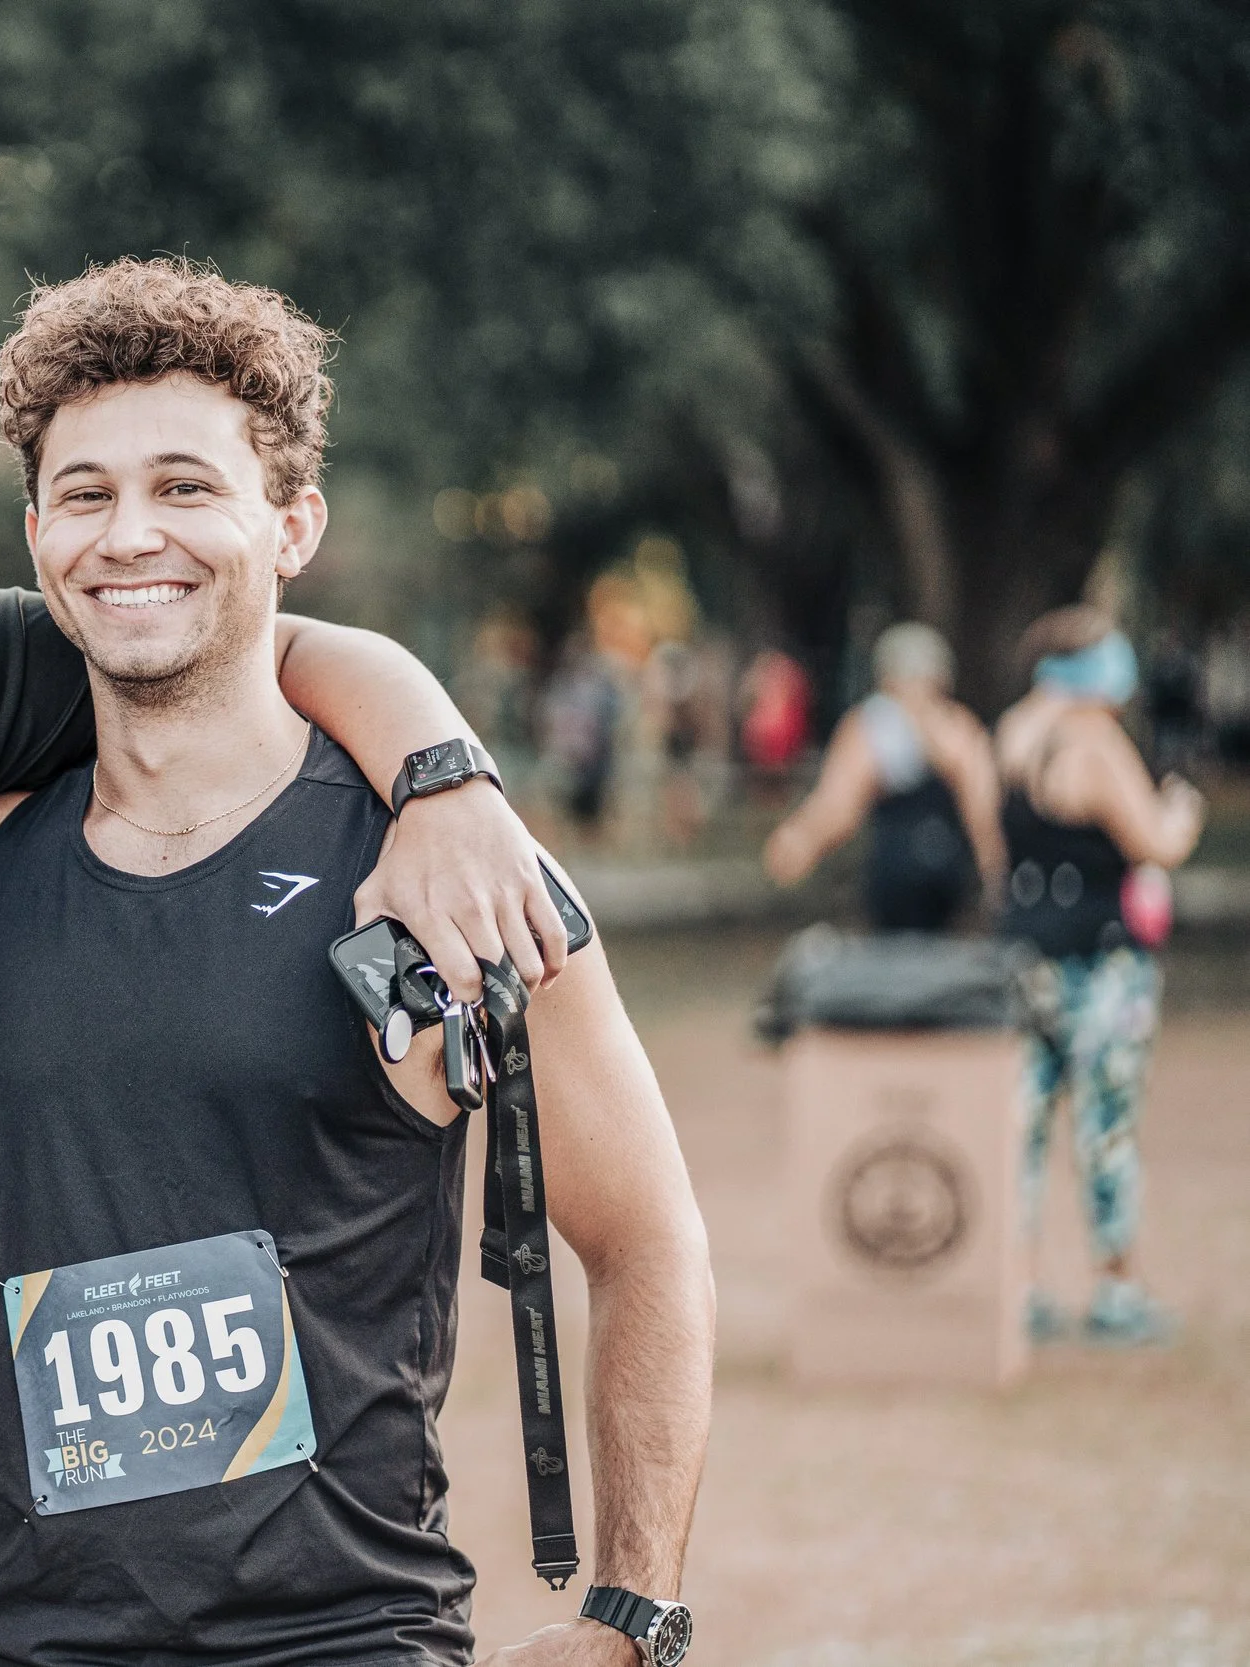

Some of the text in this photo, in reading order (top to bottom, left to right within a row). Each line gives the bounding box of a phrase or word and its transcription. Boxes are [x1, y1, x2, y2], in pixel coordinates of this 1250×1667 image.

[515, 1107, 536, 1213] MIAMI HEAT
[66, 1286, 210, 1321] LAKELAND BRANDON FLATWOODS
[84, 1271, 182, 1301] FLEET FEET
[43, 1294, 267, 1426] 1985
[529, 1310, 551, 1415] MIAMI HEAT
[56, 1427, 87, 1445] THE
[139, 1418, 218, 1456] 2024
[60, 1439, 110, 1470] BIG
[66, 1466, 104, 1487] RUN
